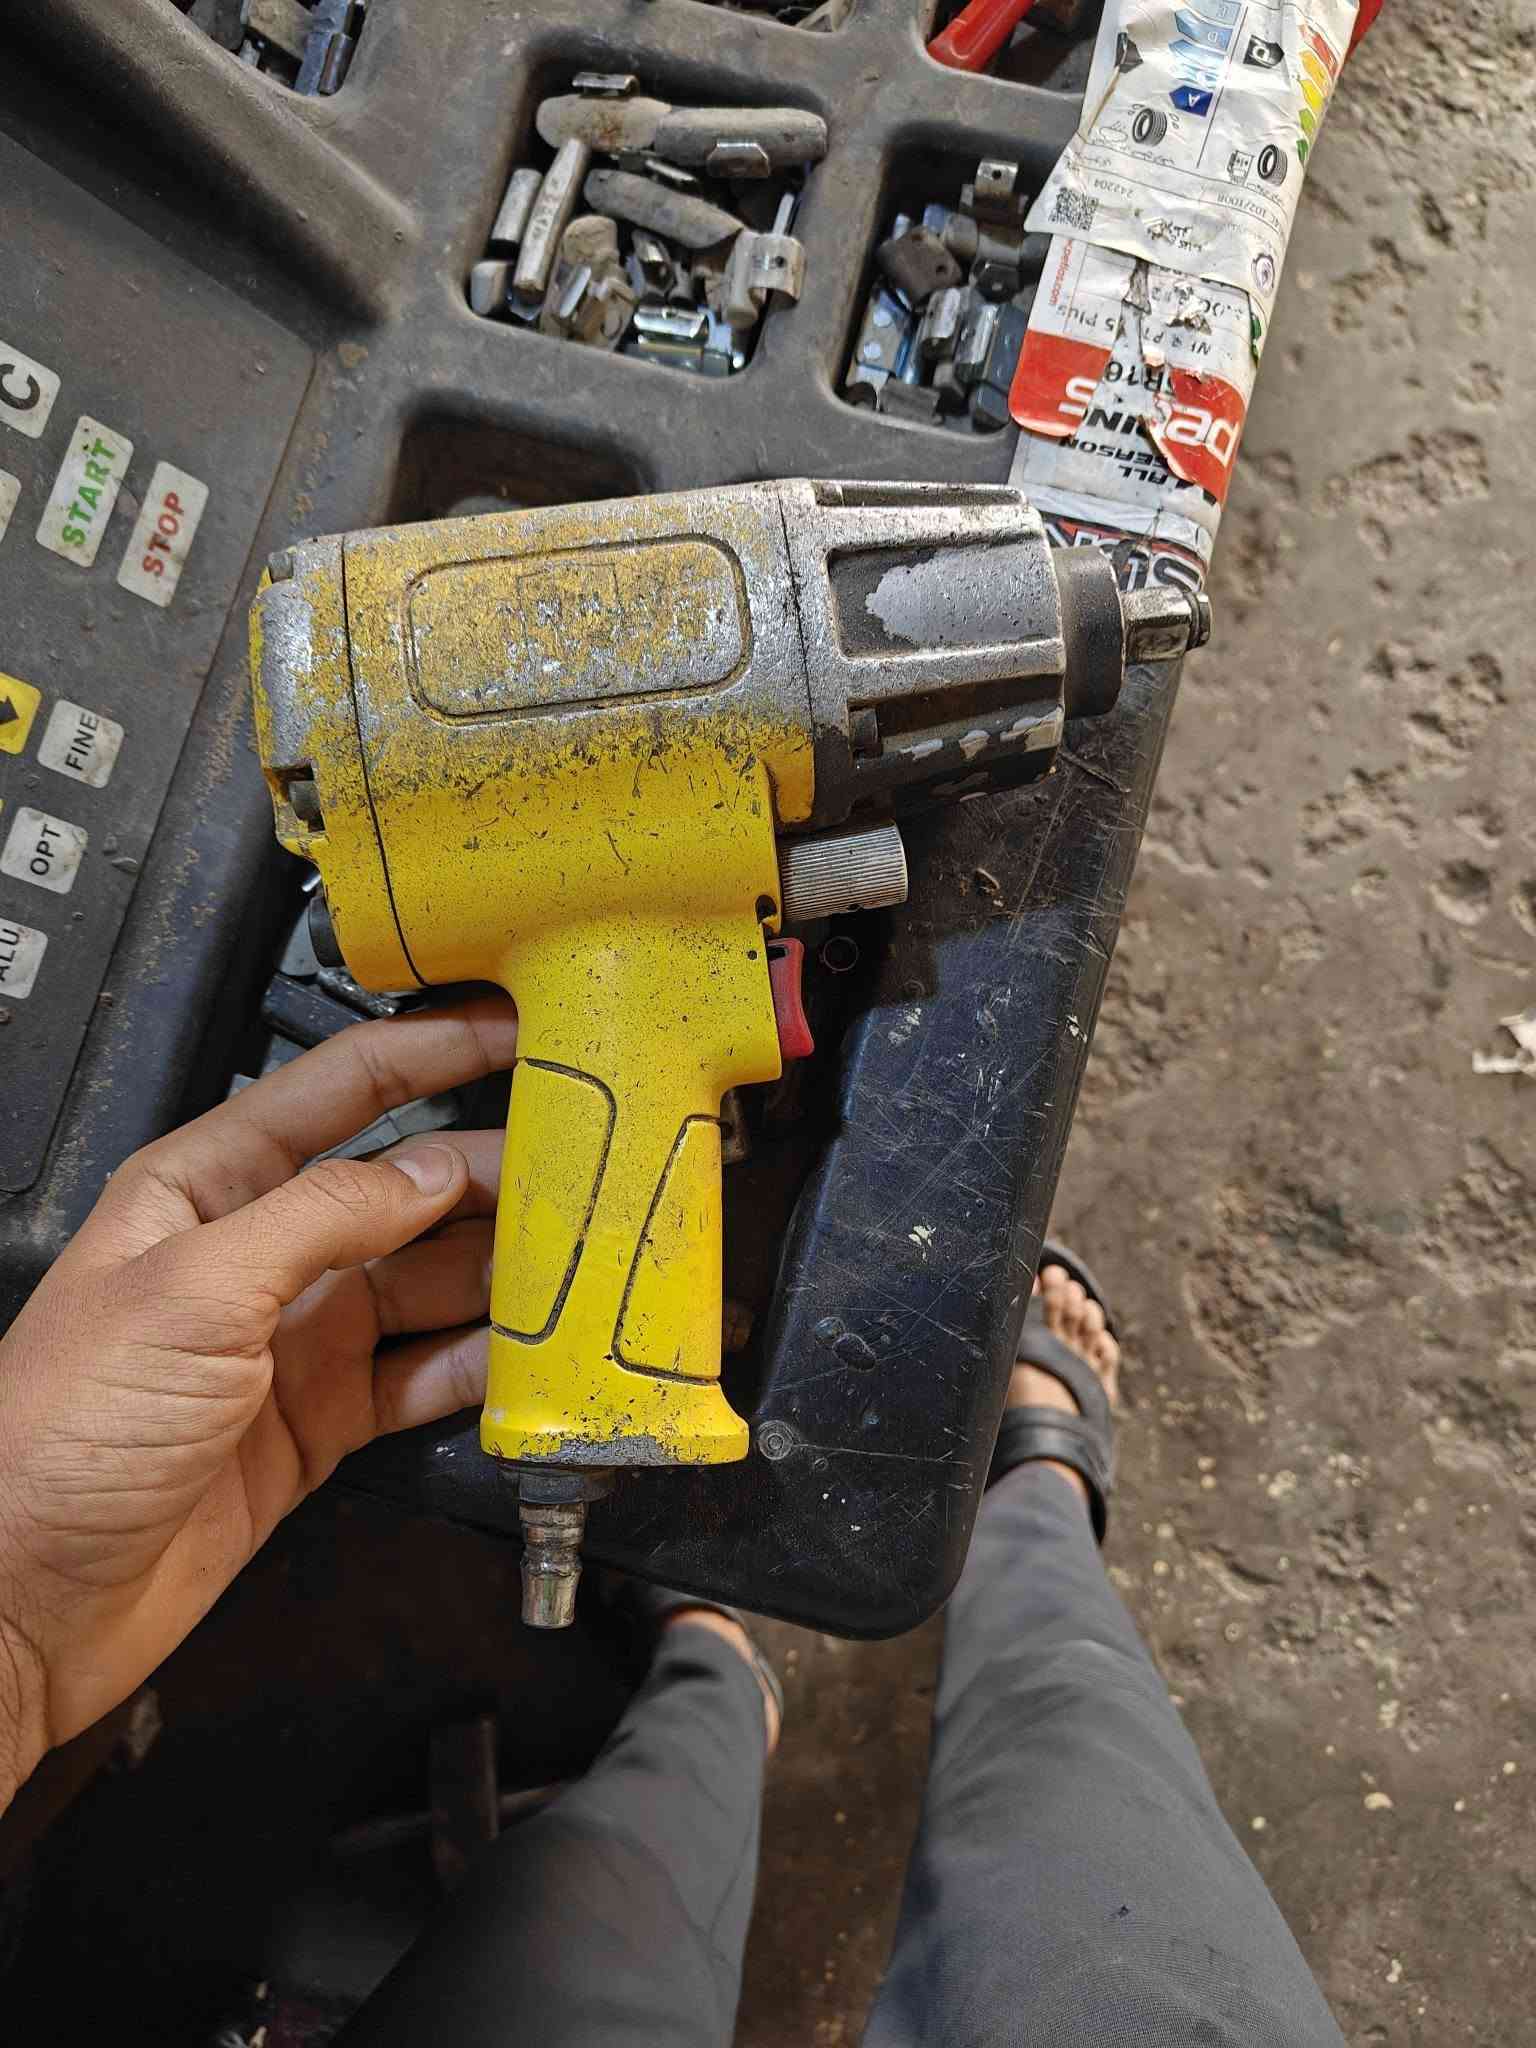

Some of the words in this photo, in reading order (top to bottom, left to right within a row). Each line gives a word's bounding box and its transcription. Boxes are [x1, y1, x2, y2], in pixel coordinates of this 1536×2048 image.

[1188, 93, 1200, 105] A
[0, 363, 41, 411] C
[62, 438, 115, 546] START
[1118, 466, 1168, 485] ALL
[142, 491, 184, 577] STOP
[65, 712, 99, 772] FINE
[30, 823, 62, 876] OPT
